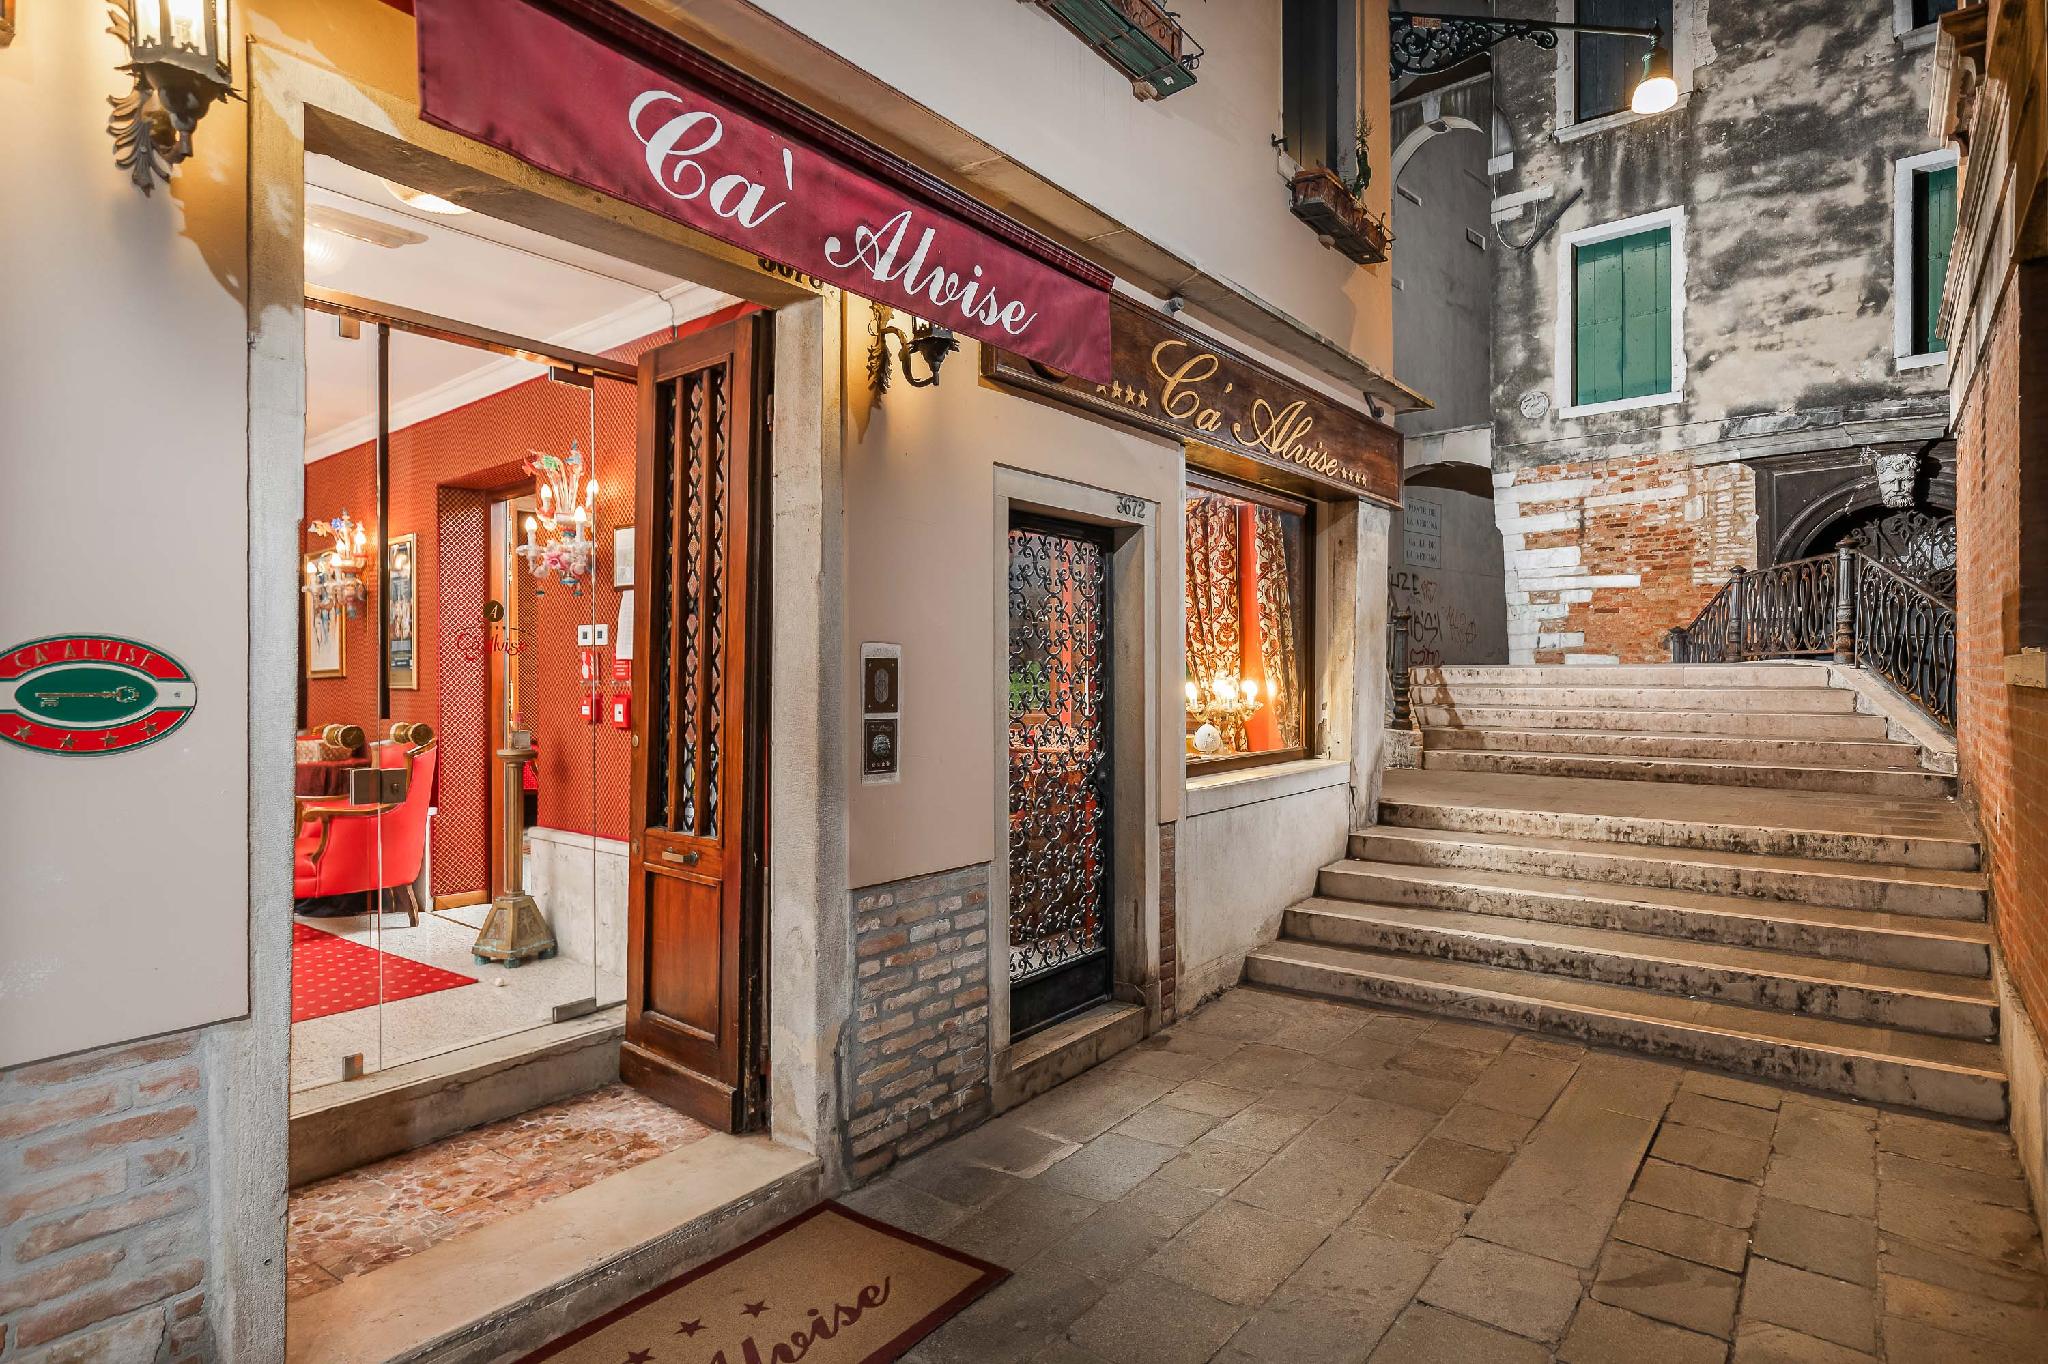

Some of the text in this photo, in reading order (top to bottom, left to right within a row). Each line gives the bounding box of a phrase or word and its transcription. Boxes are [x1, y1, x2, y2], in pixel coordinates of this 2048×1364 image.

[825, 210, 1038, 335] Alvise
[1232, 399, 1338, 477] Alvise
[64, 641, 155, 667] ALVISE
